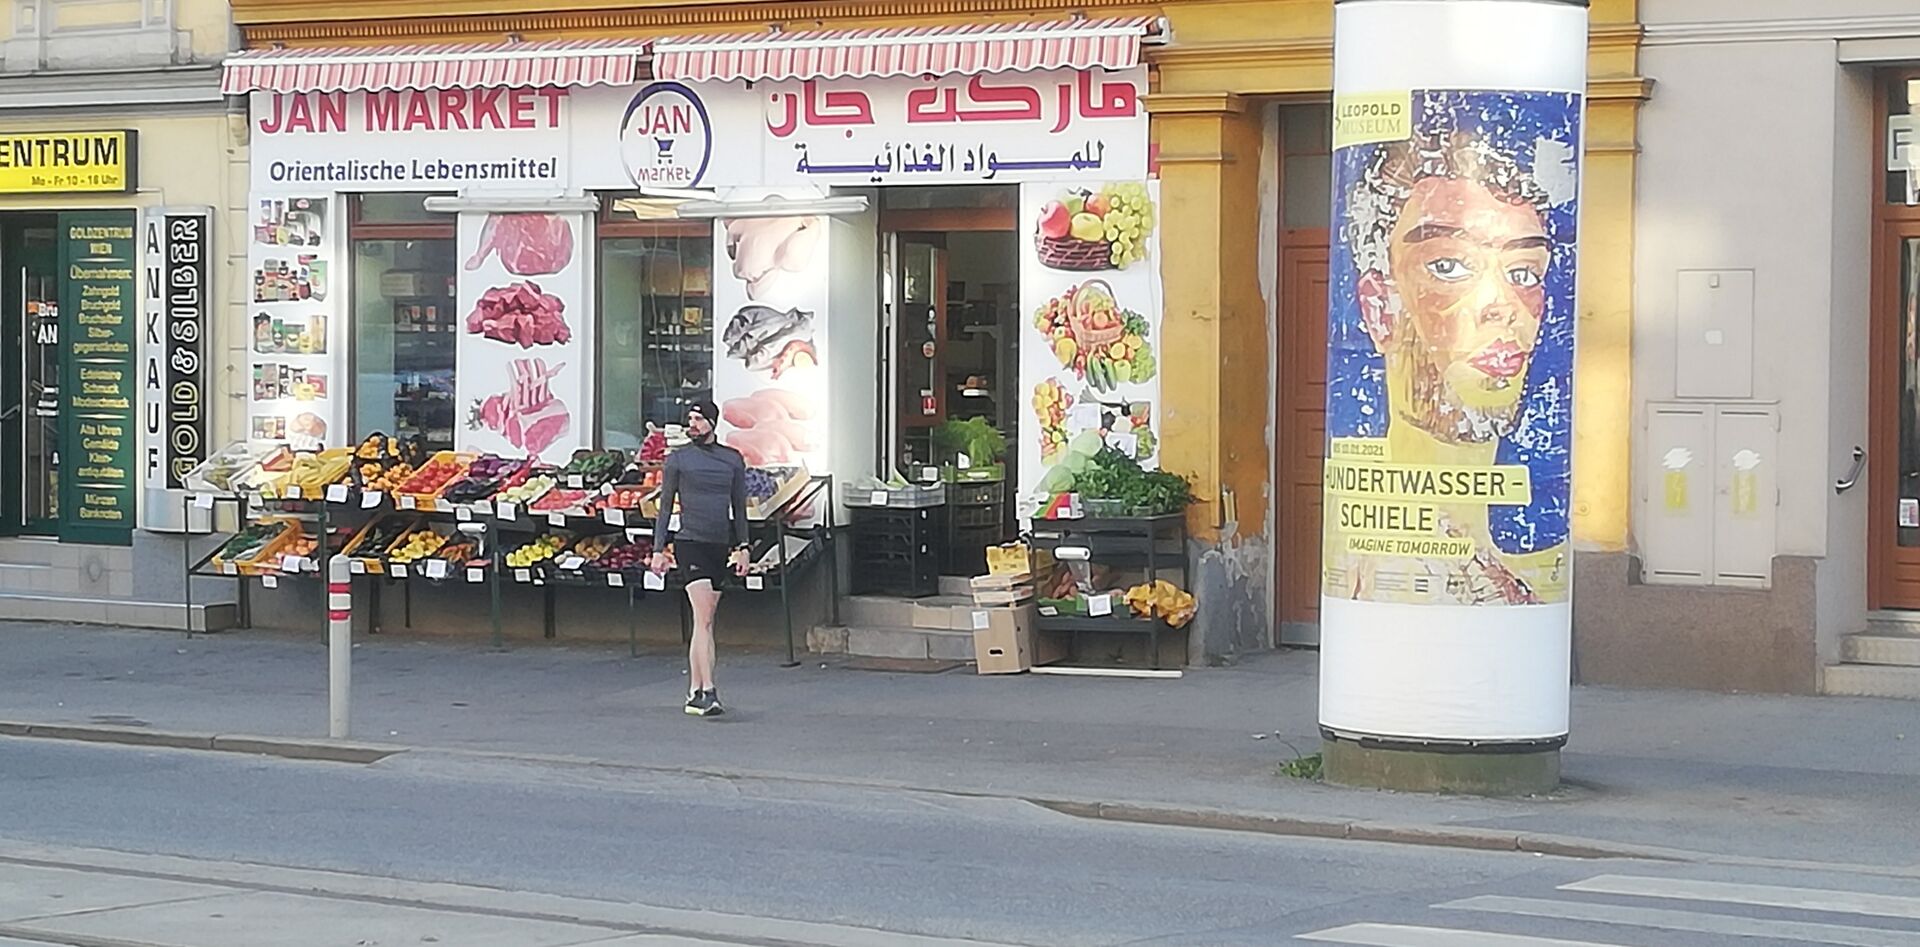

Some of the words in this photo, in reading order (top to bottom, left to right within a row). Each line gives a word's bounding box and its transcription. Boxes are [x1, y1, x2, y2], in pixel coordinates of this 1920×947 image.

[260, 92, 347, 134] JAN
[365, 87, 570, 132] MARKET
[638, 105, 691, 135] JAN
[766, 79, 875, 138] جان
[1342, 103, 1401, 118] LEOPOLD
[1341, 118, 1401, 135] MUSEUM
[32, 176, 45, 186] Mo
[54, 176, 64, 186] Fr
[67, 175, 78, 185] 10
[102, 174, 118, 185] Uhr
[269, 159, 406, 182] Orientalische
[411, 157, 557, 181] Lebensmittel
[171, 219, 199, 343] SILBER
[171, 346, 199, 374] &
[171, 380, 199, 482] GOLD
[1326, 465, 1505, 497] UNDERTWASSER
[1340, 503, 1433, 532] SCHIELE
[1349, 538, 1394, 553] IMAGINE
[1396, 539, 1472, 557] TOMORROW
